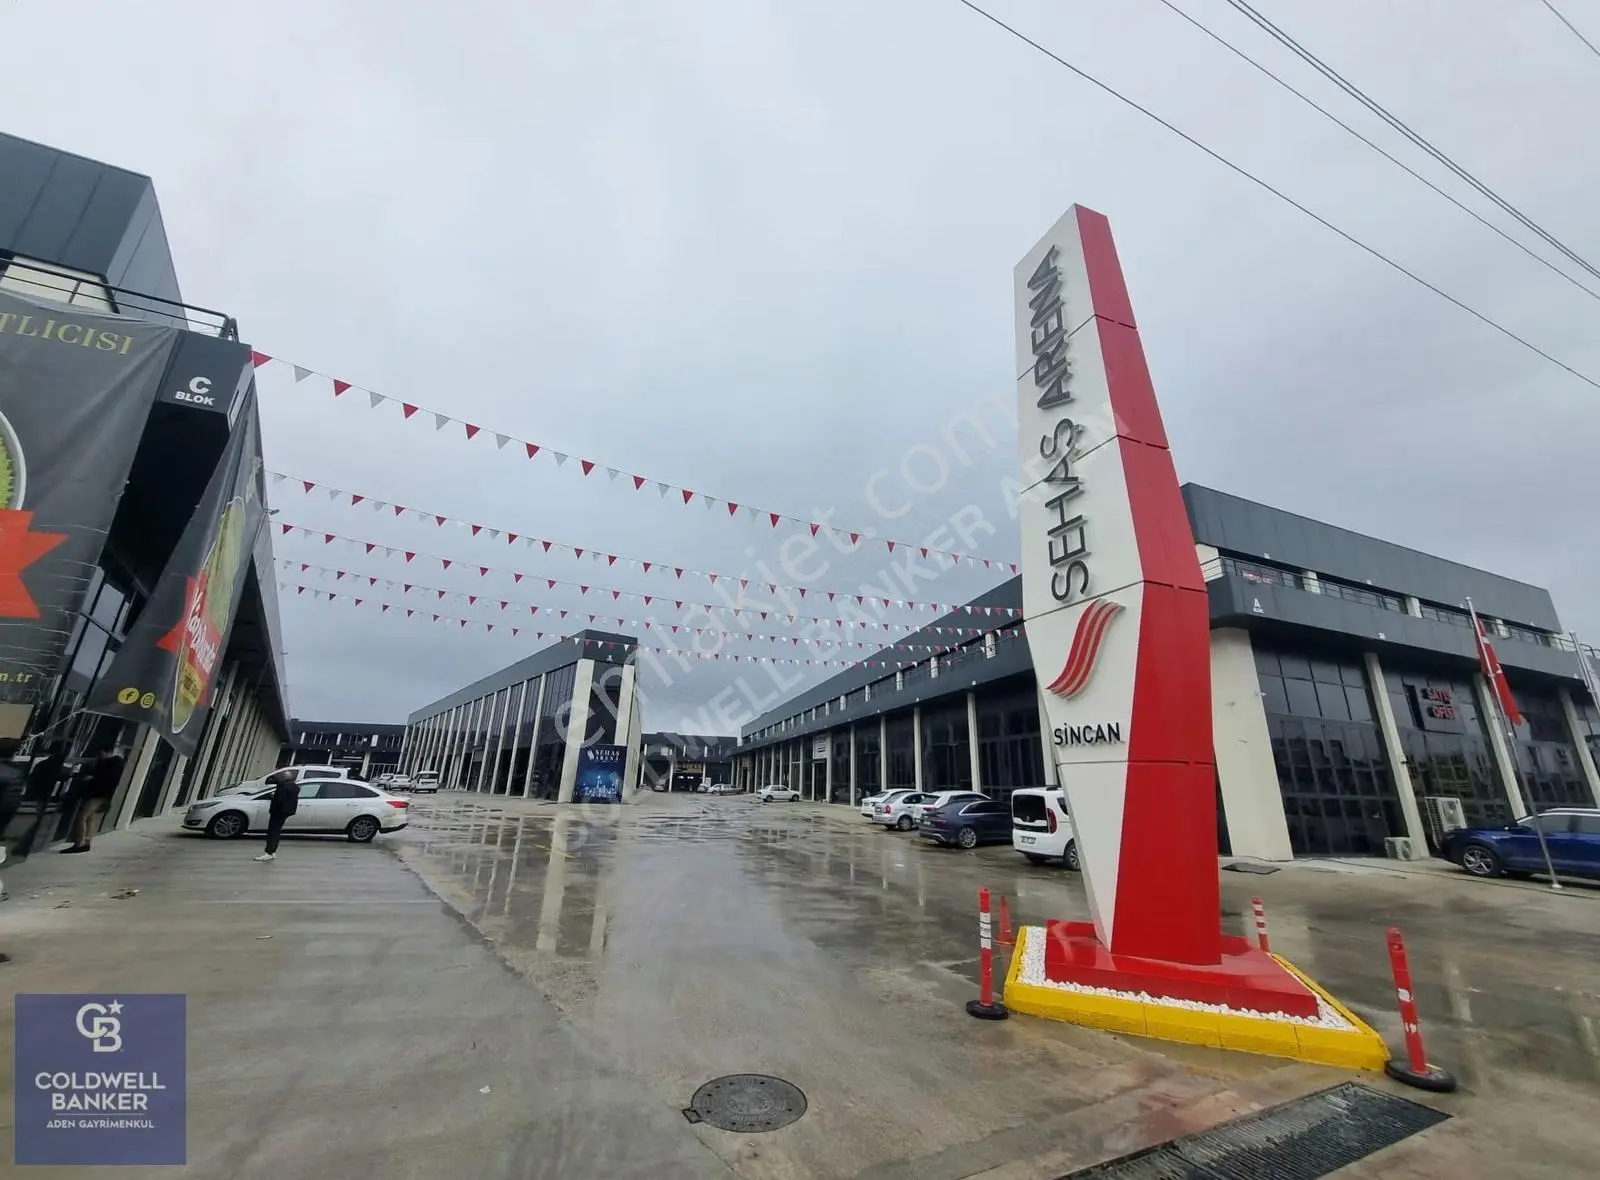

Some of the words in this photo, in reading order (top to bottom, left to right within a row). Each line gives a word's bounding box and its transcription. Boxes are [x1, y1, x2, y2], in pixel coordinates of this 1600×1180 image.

[1027, 244, 1075, 411] ARENA
[190, 376, 212, 394] C
[175, 391, 216, 406] BLOK
[1040, 416, 1091, 602] SEHAS
[1053, 721, 1122, 746] SİNCAN
